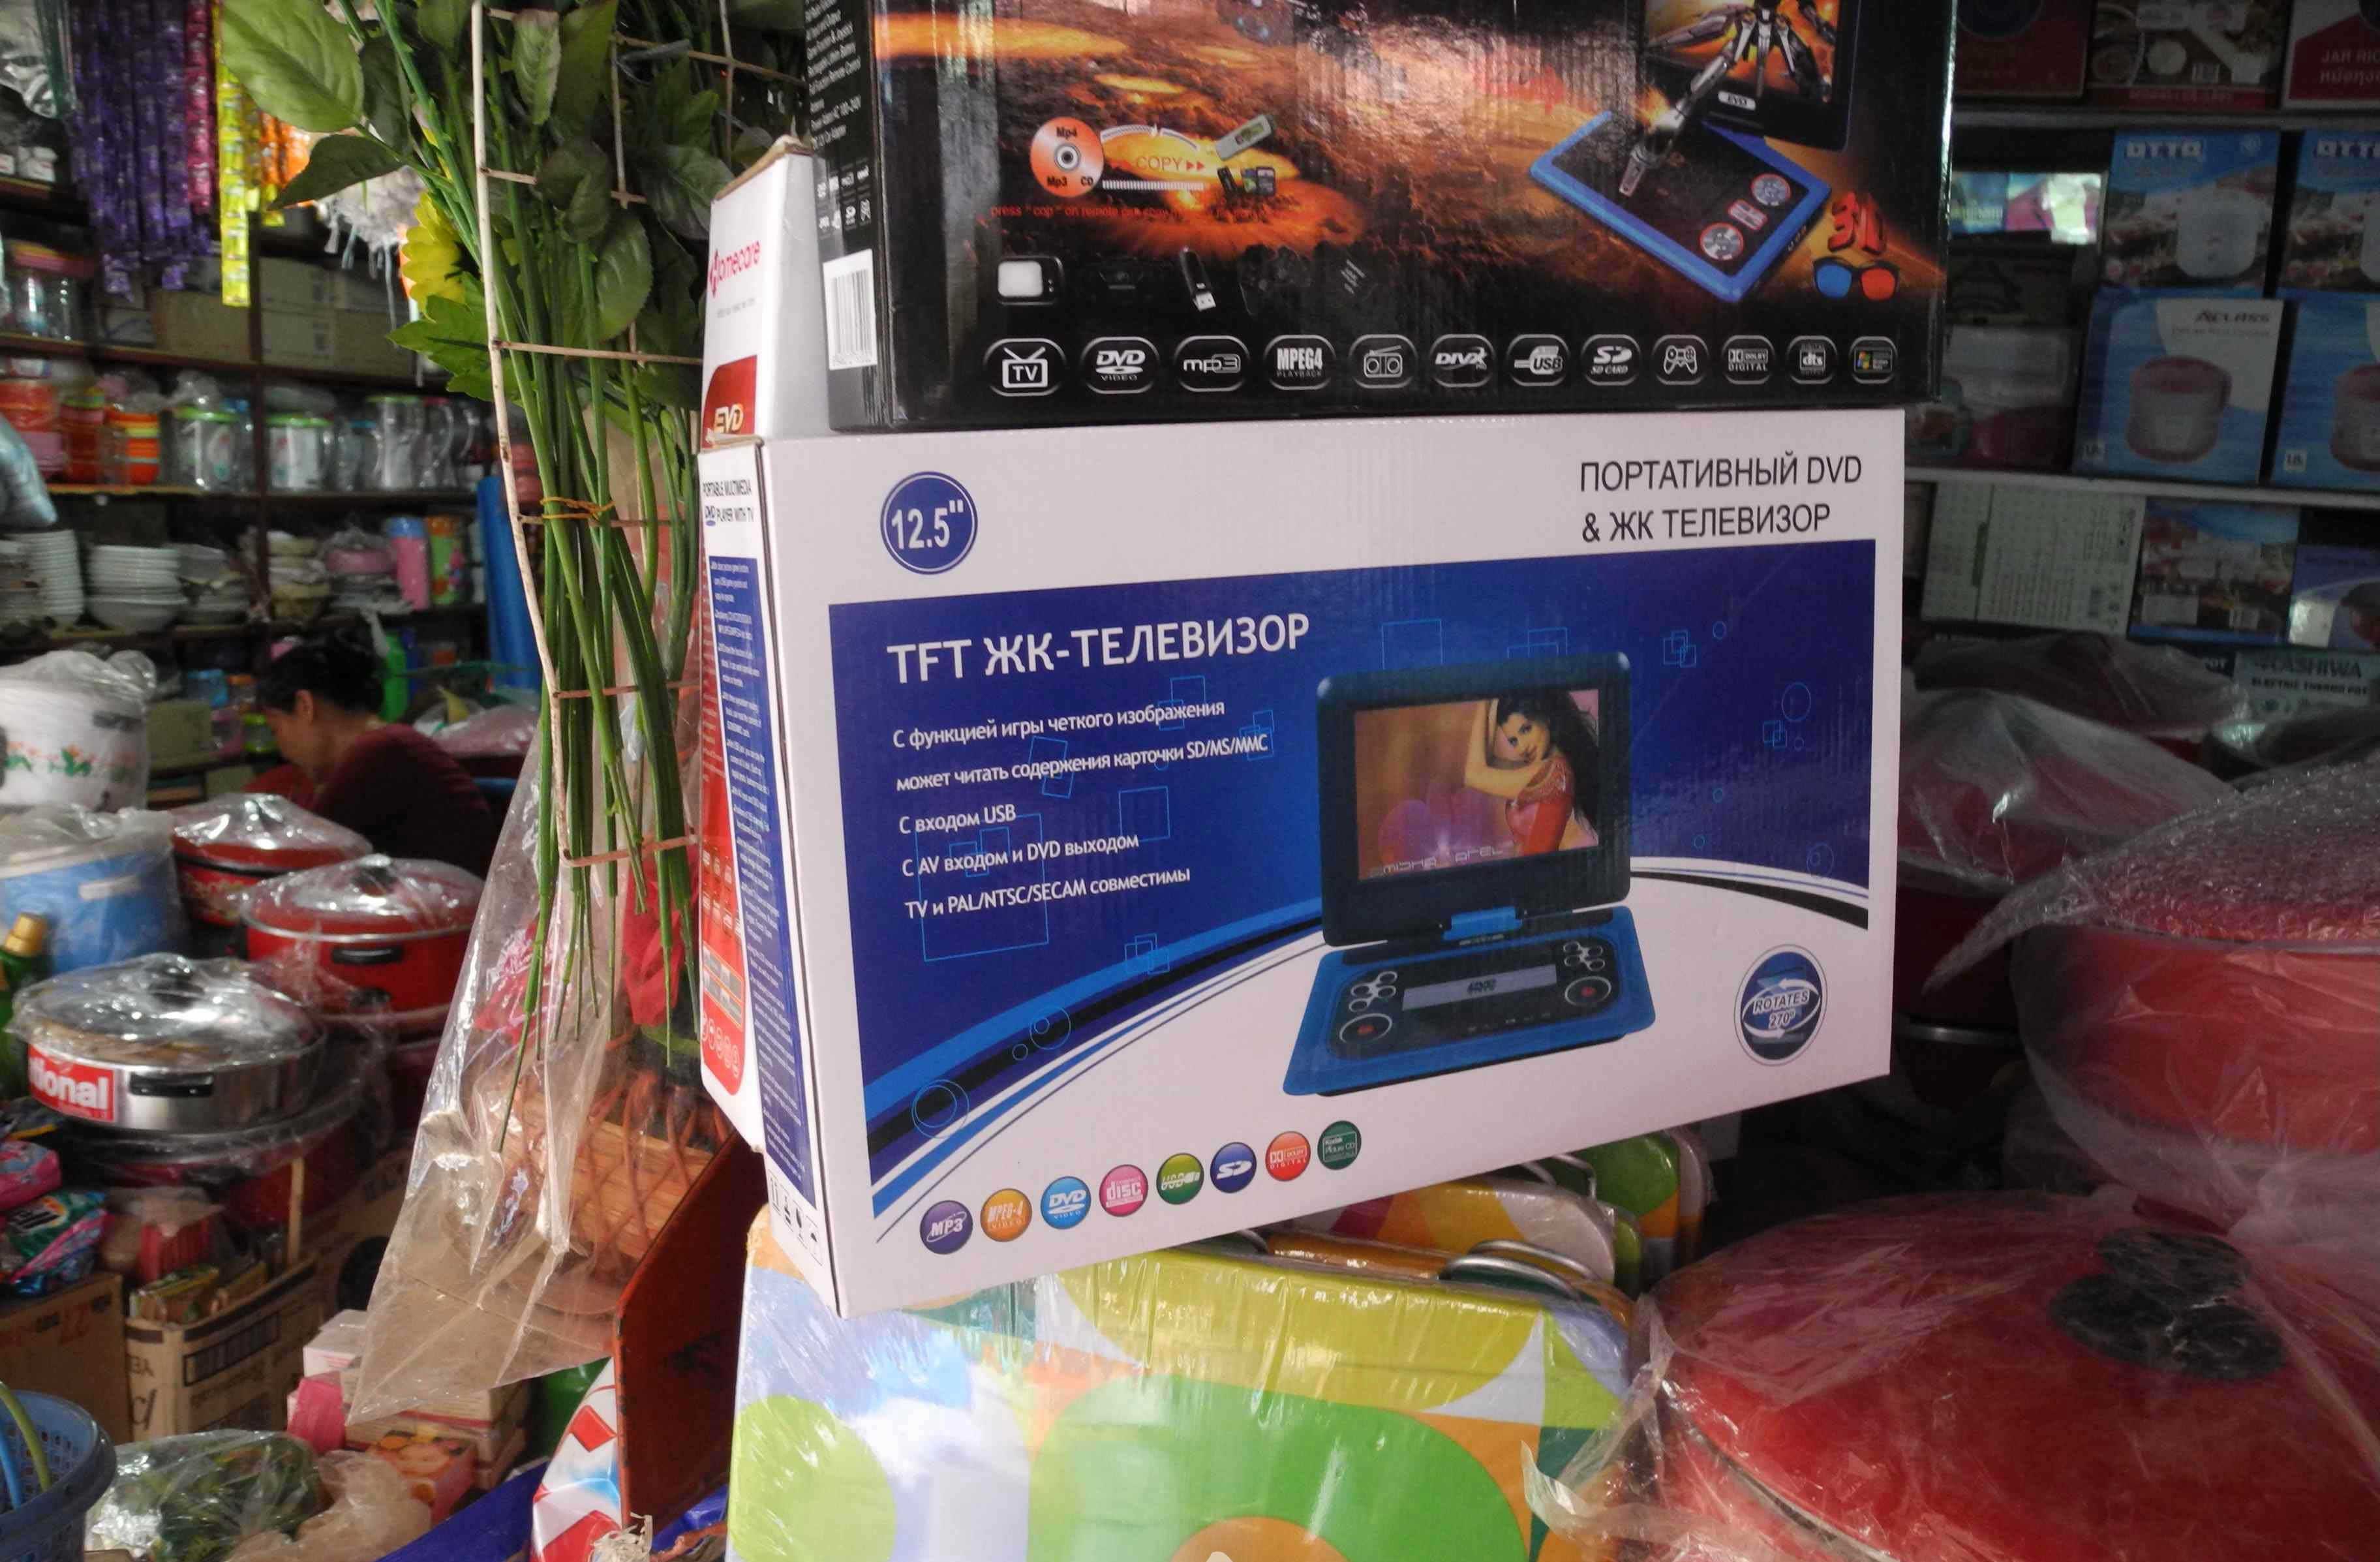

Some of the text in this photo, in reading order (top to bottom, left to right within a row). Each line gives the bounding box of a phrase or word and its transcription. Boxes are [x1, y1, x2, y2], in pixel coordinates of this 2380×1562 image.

[1135, 155, 1182, 172] COPY
[1829, 192, 1887, 254] 3D
[1097, 350, 1146, 367] DVD
[1183, 353, 1240, 374] mp3
[1277, 347, 1323, 369] MPEG4
[1533, 357, 1563, 371] USB
[1728, 363, 1768, 371] DIGITAL
[1013, 365, 1039, 382] TV
[714, 404, 744, 433] EVD
[1580, 450, 1862, 492] ПОРТАТИВНЫЙ DVD
[1581, 503, 1831, 543] & ЖК ТЕЛЕВИЗОР
[886, 612, 1309, 684] TFT ЖК-ТЕЛЕВИЗОР
[893, 701, 1225, 750] С функцией игры четкого изображения
[896, 733, 1269, 791] может читать содержения карточки SD/MS/MMC
[899, 803, 1017, 835] С входом USB
[902, 833, 1140, 877] С AV входом и DVD выходом
[905, 867, 1191, 920] TV и PAL/NTSC/SECAM совместимы
[1753, 989, 1810, 1015] ROTATES
[1269, 1157, 1307, 1170] DIGITAL
[1048, 1189, 1086, 1208] DVD
[1106, 1182, 1142, 1200] disc
[987, 1201, 1024, 1222] MPEG-4
[1054, 1210, 1082, 1219] VIDEO
[931, 1218, 963, 1238] MP3
